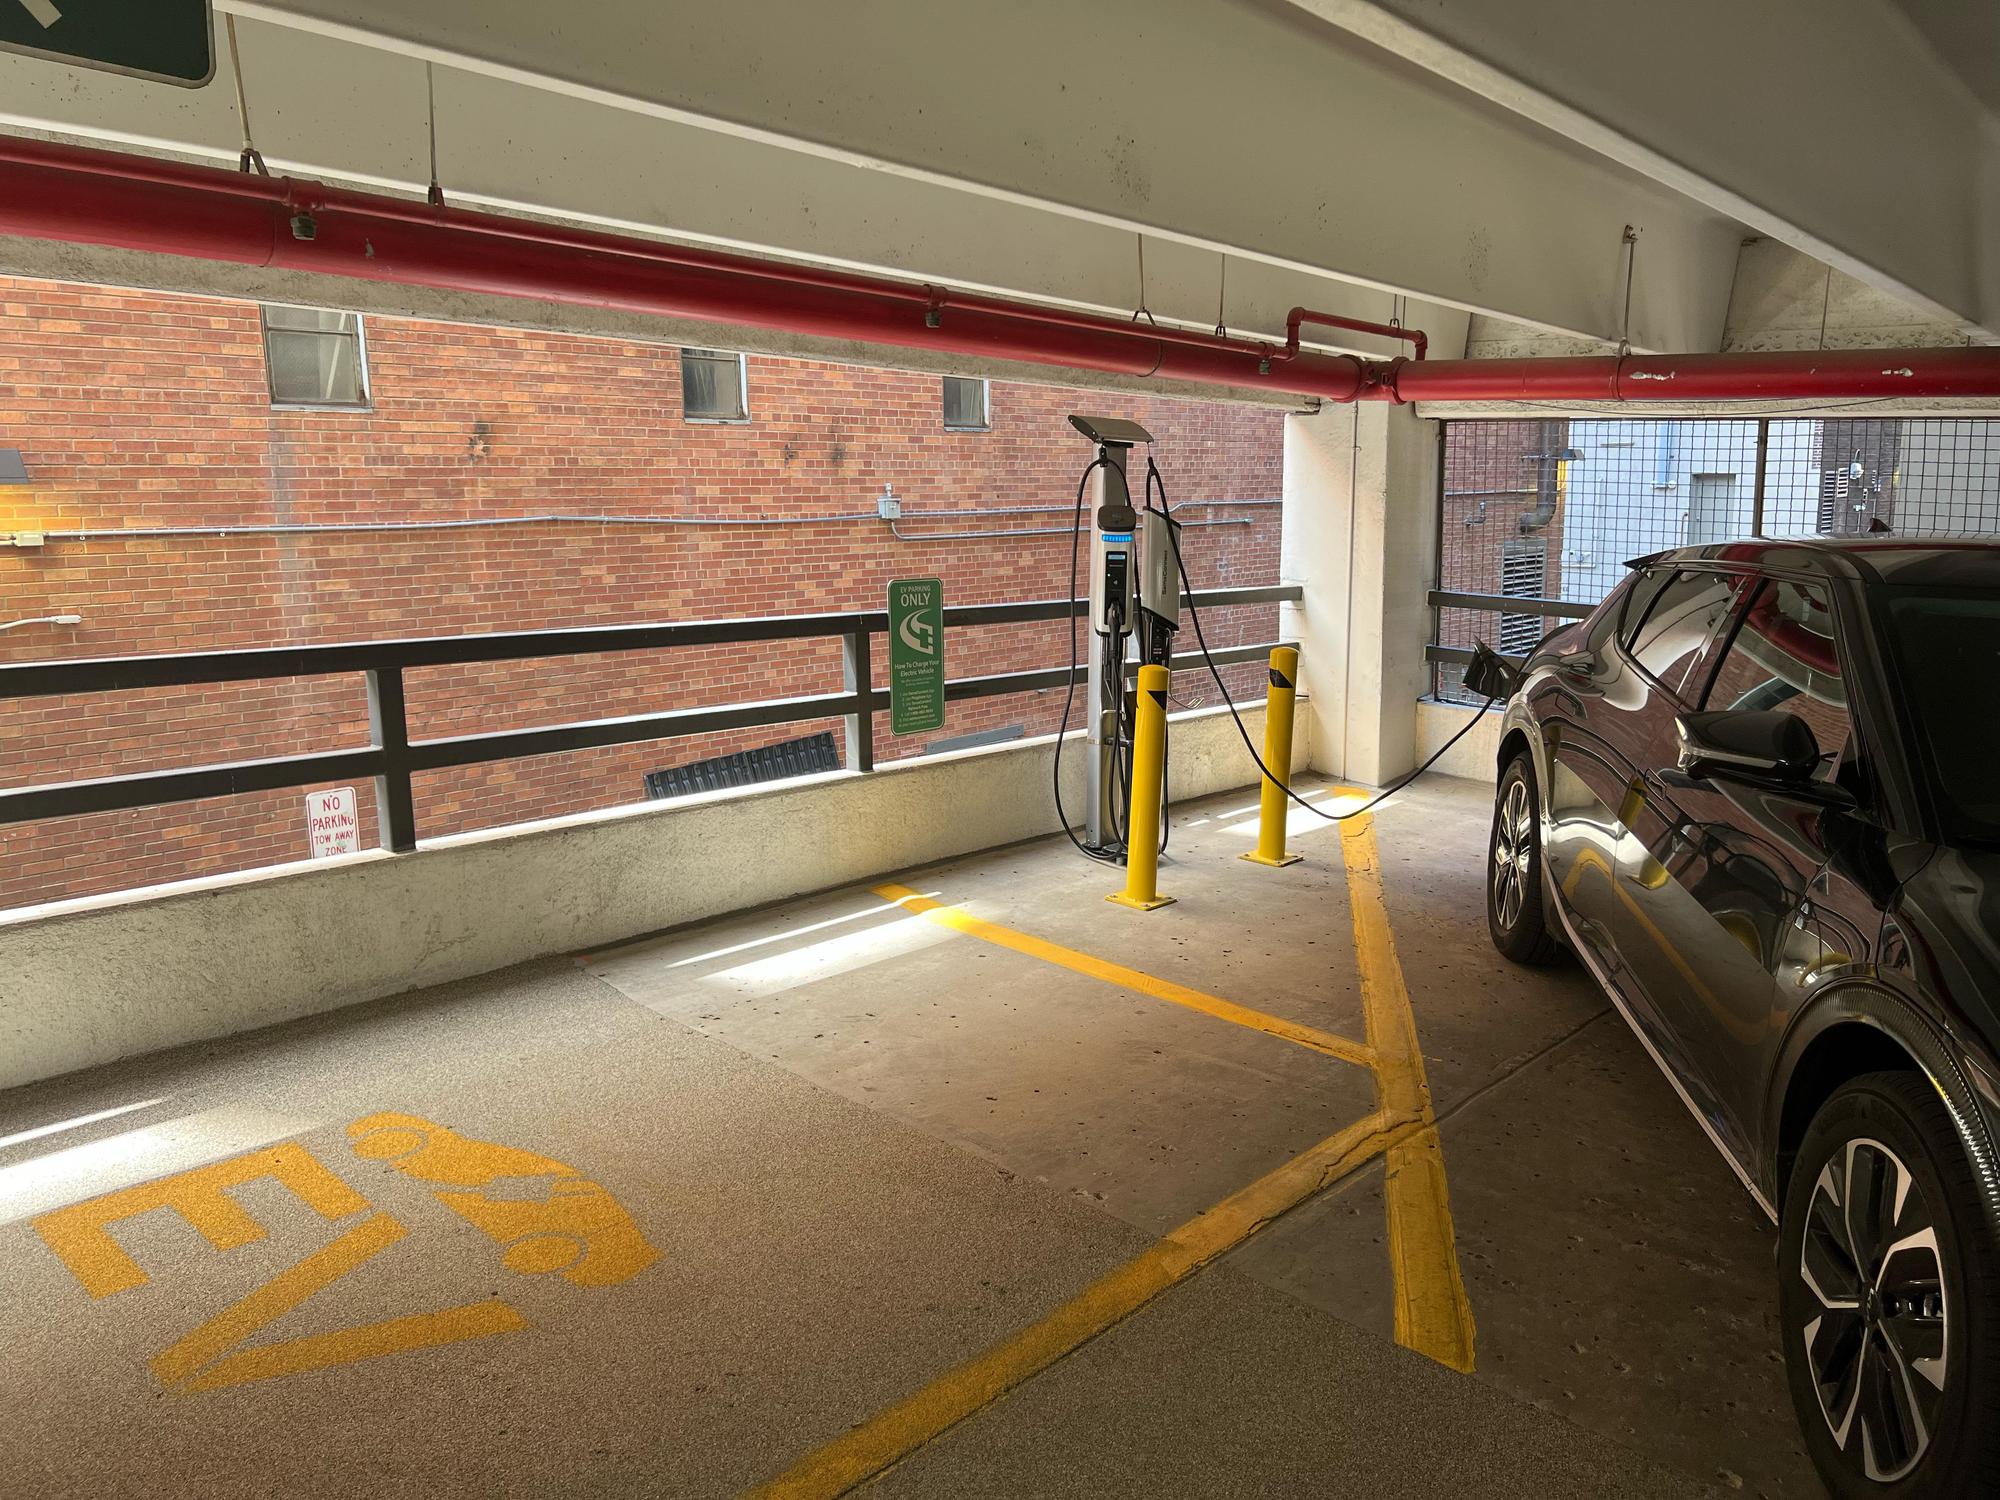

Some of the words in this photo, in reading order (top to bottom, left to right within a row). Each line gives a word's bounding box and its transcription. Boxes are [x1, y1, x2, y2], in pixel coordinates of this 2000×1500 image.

[908, 585, 931, 593] PARKING
[900, 592, 931, 607] ONLY
[323, 797, 340, 812] NO
[312, 814, 354, 832] PARKING
[314, 834, 331, 846] TOW
[335, 830, 354, 842] AWAY
[325, 845, 347, 857] ZONE
[30, 1141, 531, 1397] EV
